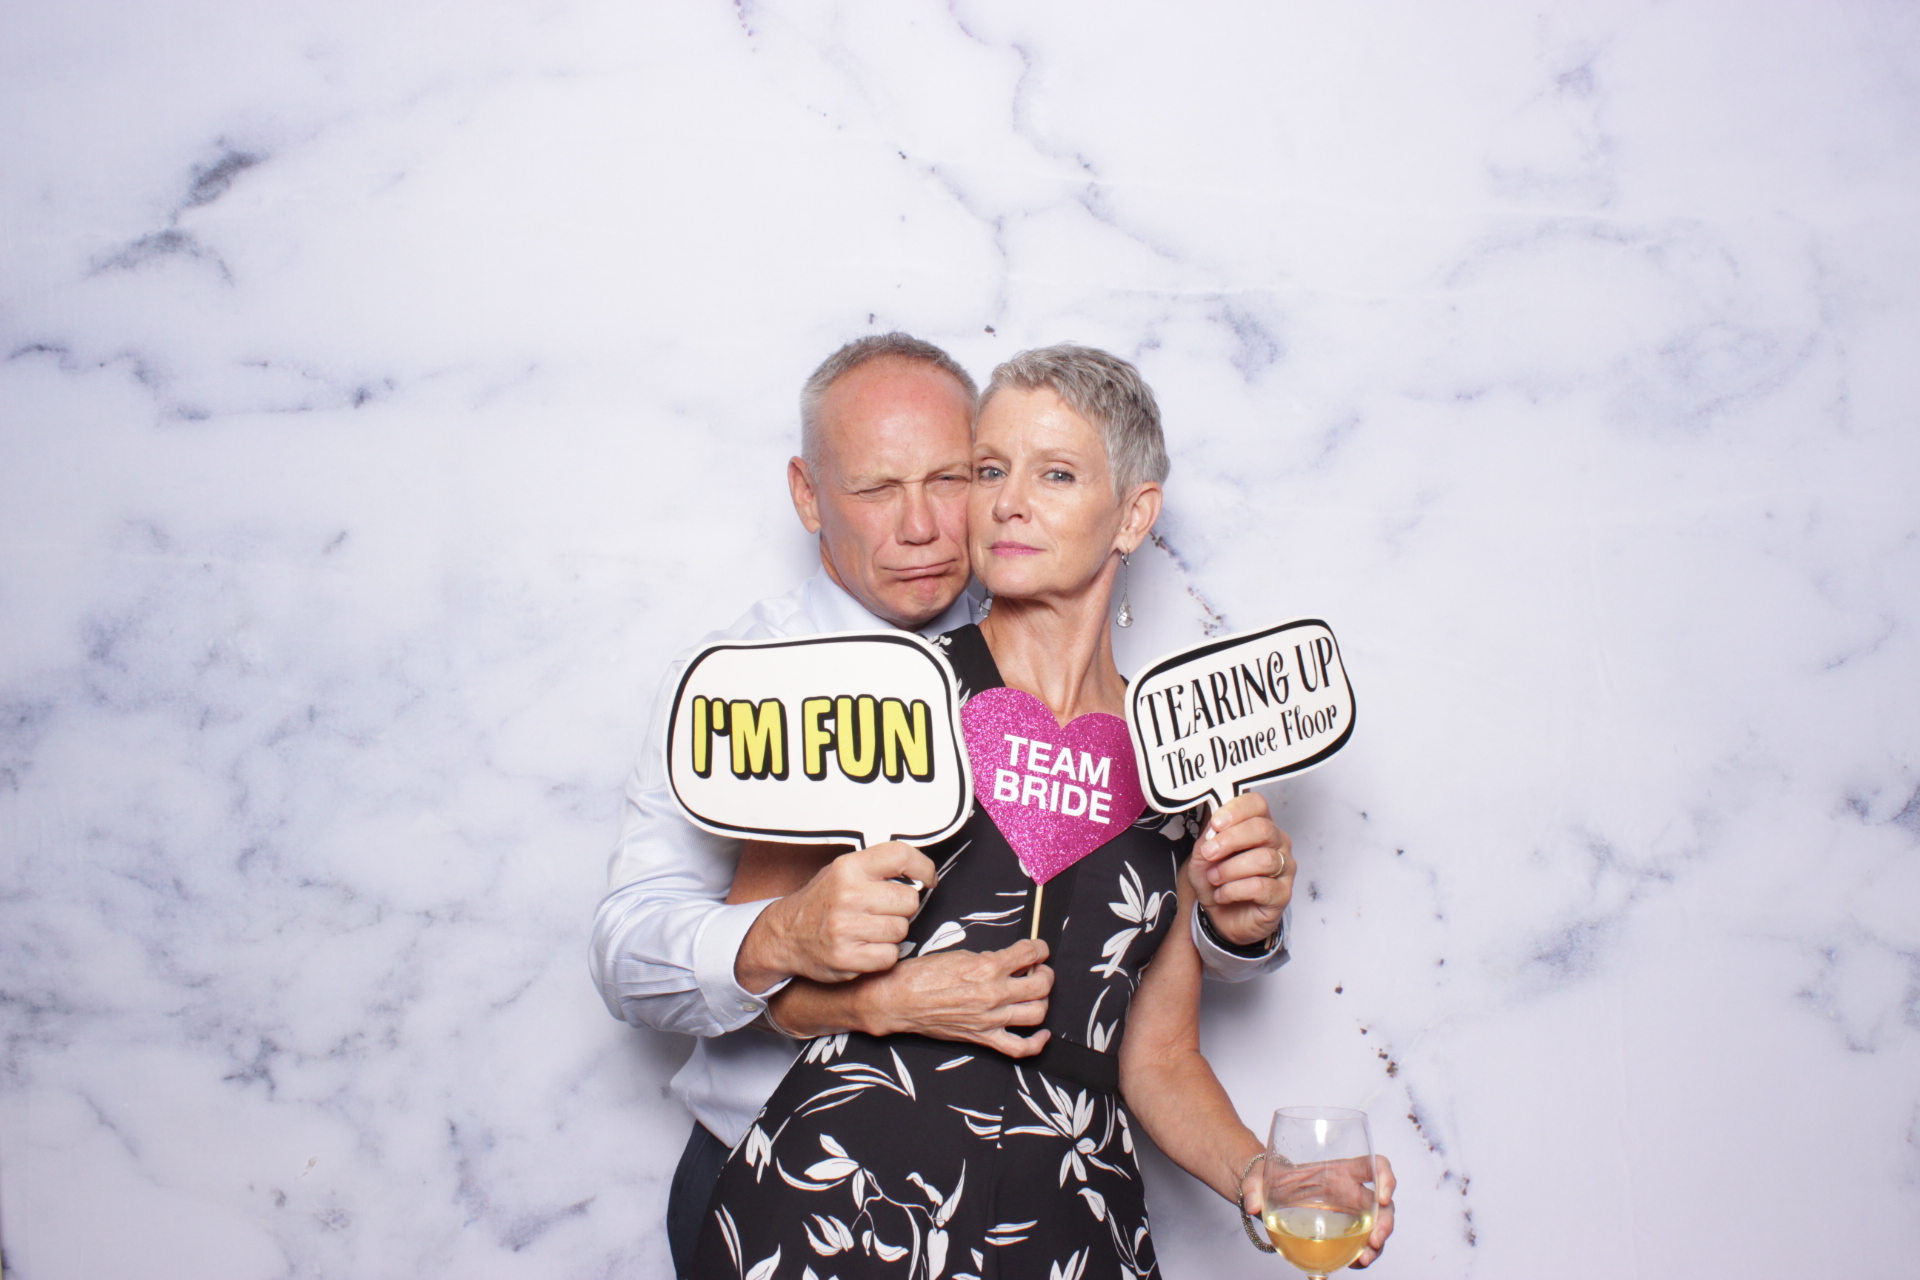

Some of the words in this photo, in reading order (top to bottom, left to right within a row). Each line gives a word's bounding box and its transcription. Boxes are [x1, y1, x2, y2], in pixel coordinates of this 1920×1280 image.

[1140, 651, 1289, 747] TEARING
[1294, 636, 1333, 692] UP
[692, 695, 789, 781] I'M
[802, 694, 935, 784] FUN
[1004, 733, 1111, 788] TEAM
[1161, 747, 1207, 789] The
[1209, 727, 1278, 774] Dance
[1280, 705, 1337, 746] Floor
[993, 768, 1113, 825] BRIDE
